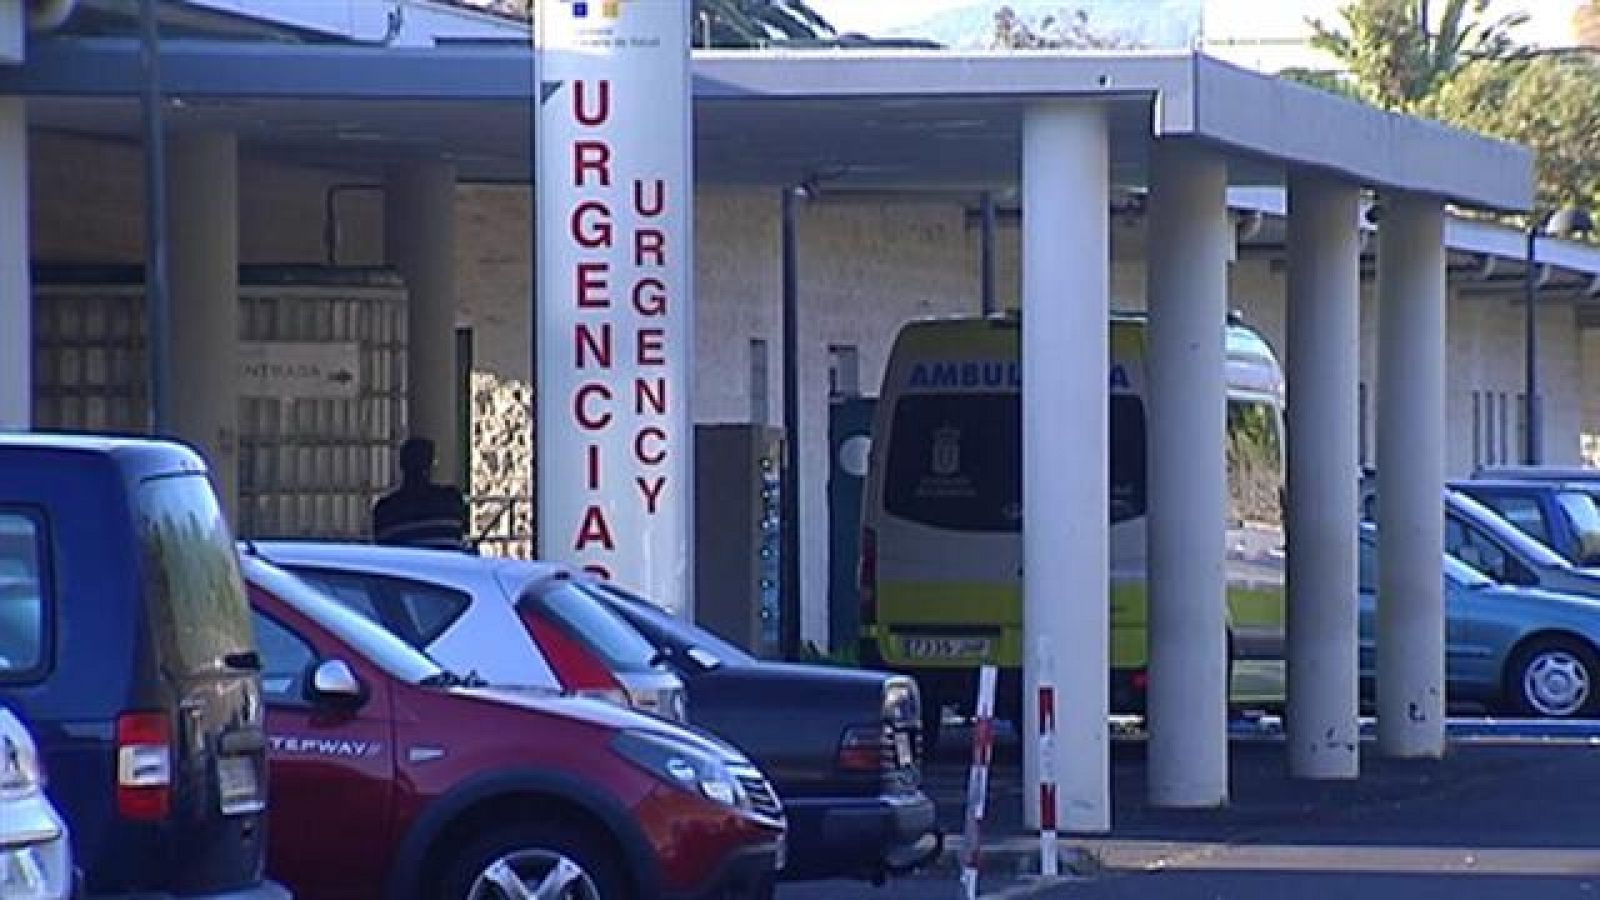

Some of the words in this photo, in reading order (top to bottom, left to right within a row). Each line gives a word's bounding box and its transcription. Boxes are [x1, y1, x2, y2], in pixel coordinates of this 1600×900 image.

[571, 80, 614, 580] URGENCIA
[632, 179, 667, 516] URGENCY
[241, 365, 321, 379] NTRADA
[908, 363, 1132, 388] AMBULA
[269, 738, 368, 757] TEPWAY
